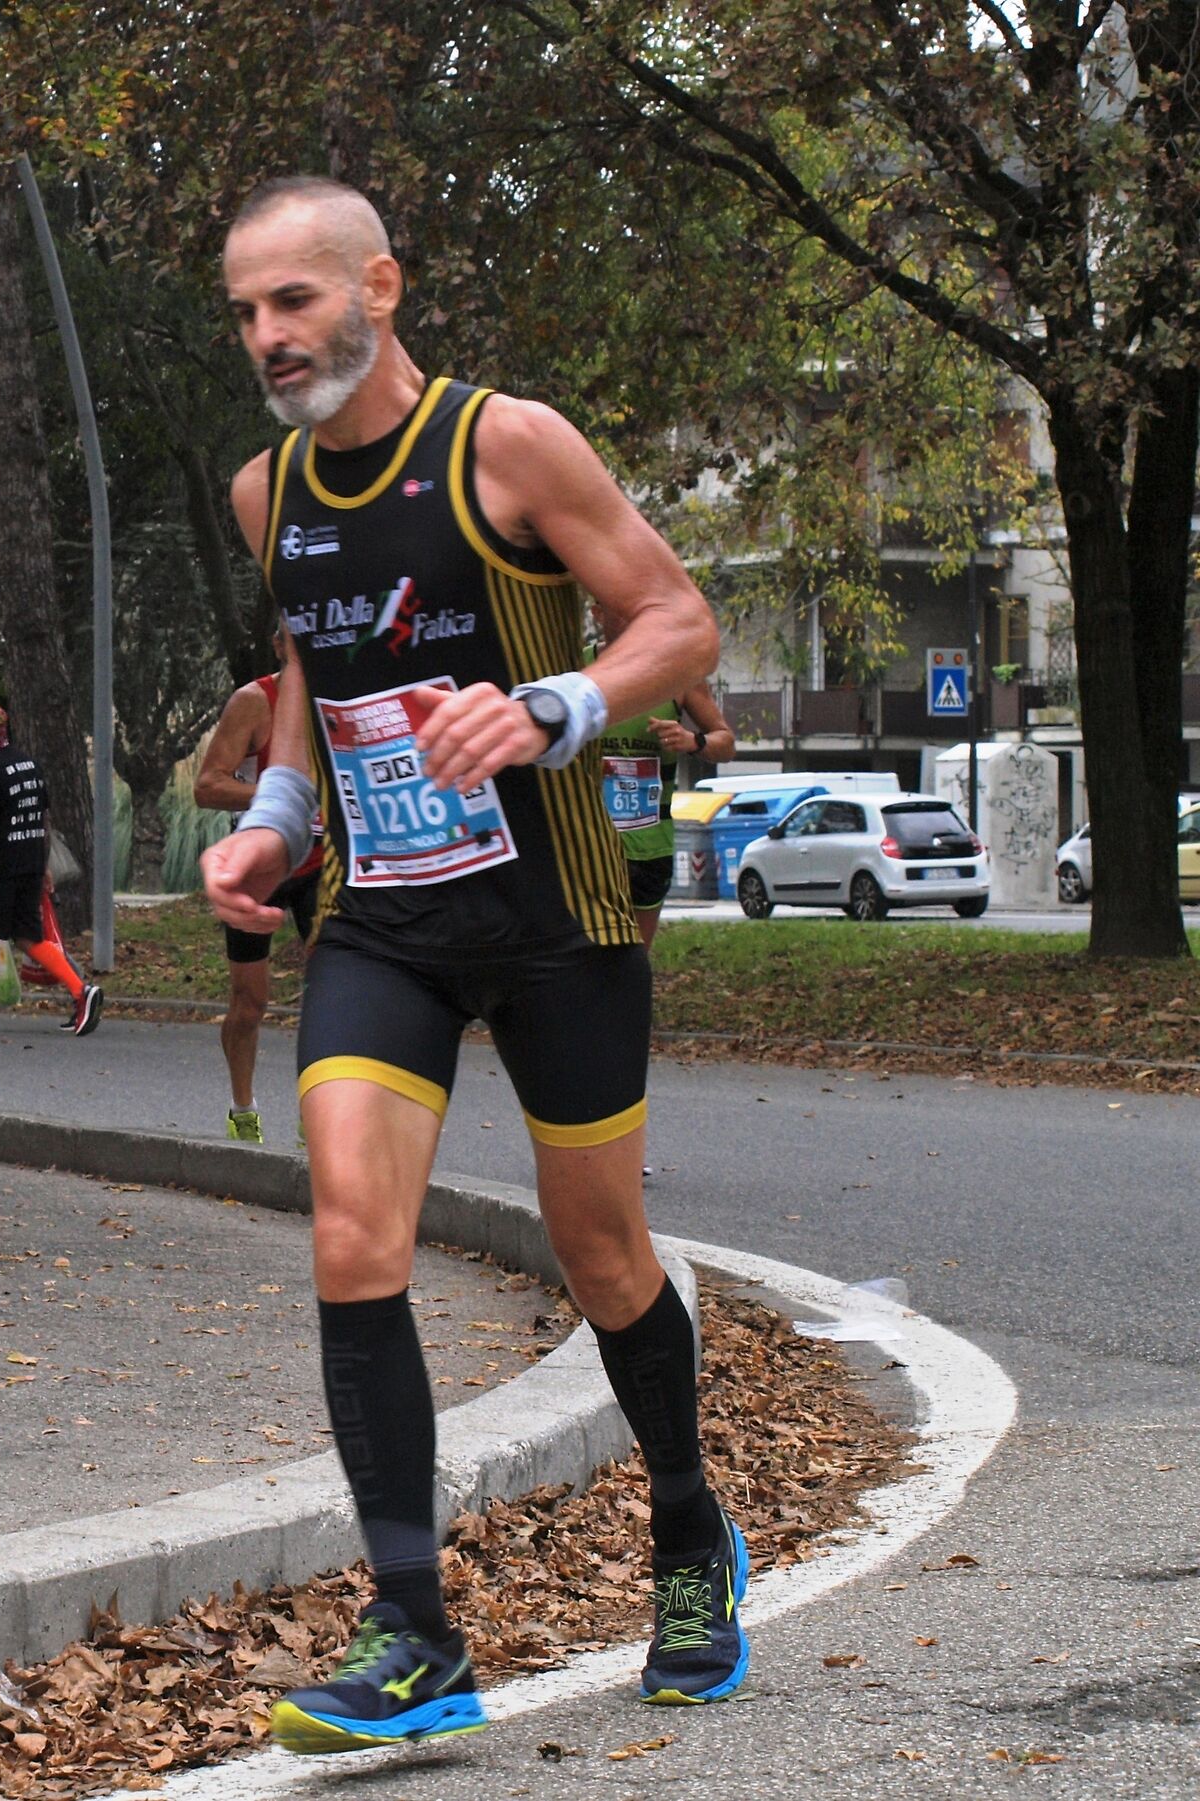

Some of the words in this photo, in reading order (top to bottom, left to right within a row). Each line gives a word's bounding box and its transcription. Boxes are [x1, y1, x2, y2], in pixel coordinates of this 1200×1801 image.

[325, 594, 376, 631] Della
[411, 607, 476, 648] Fatica
[367, 781, 448, 833] 1216
[613, 792, 640, 811] 615
